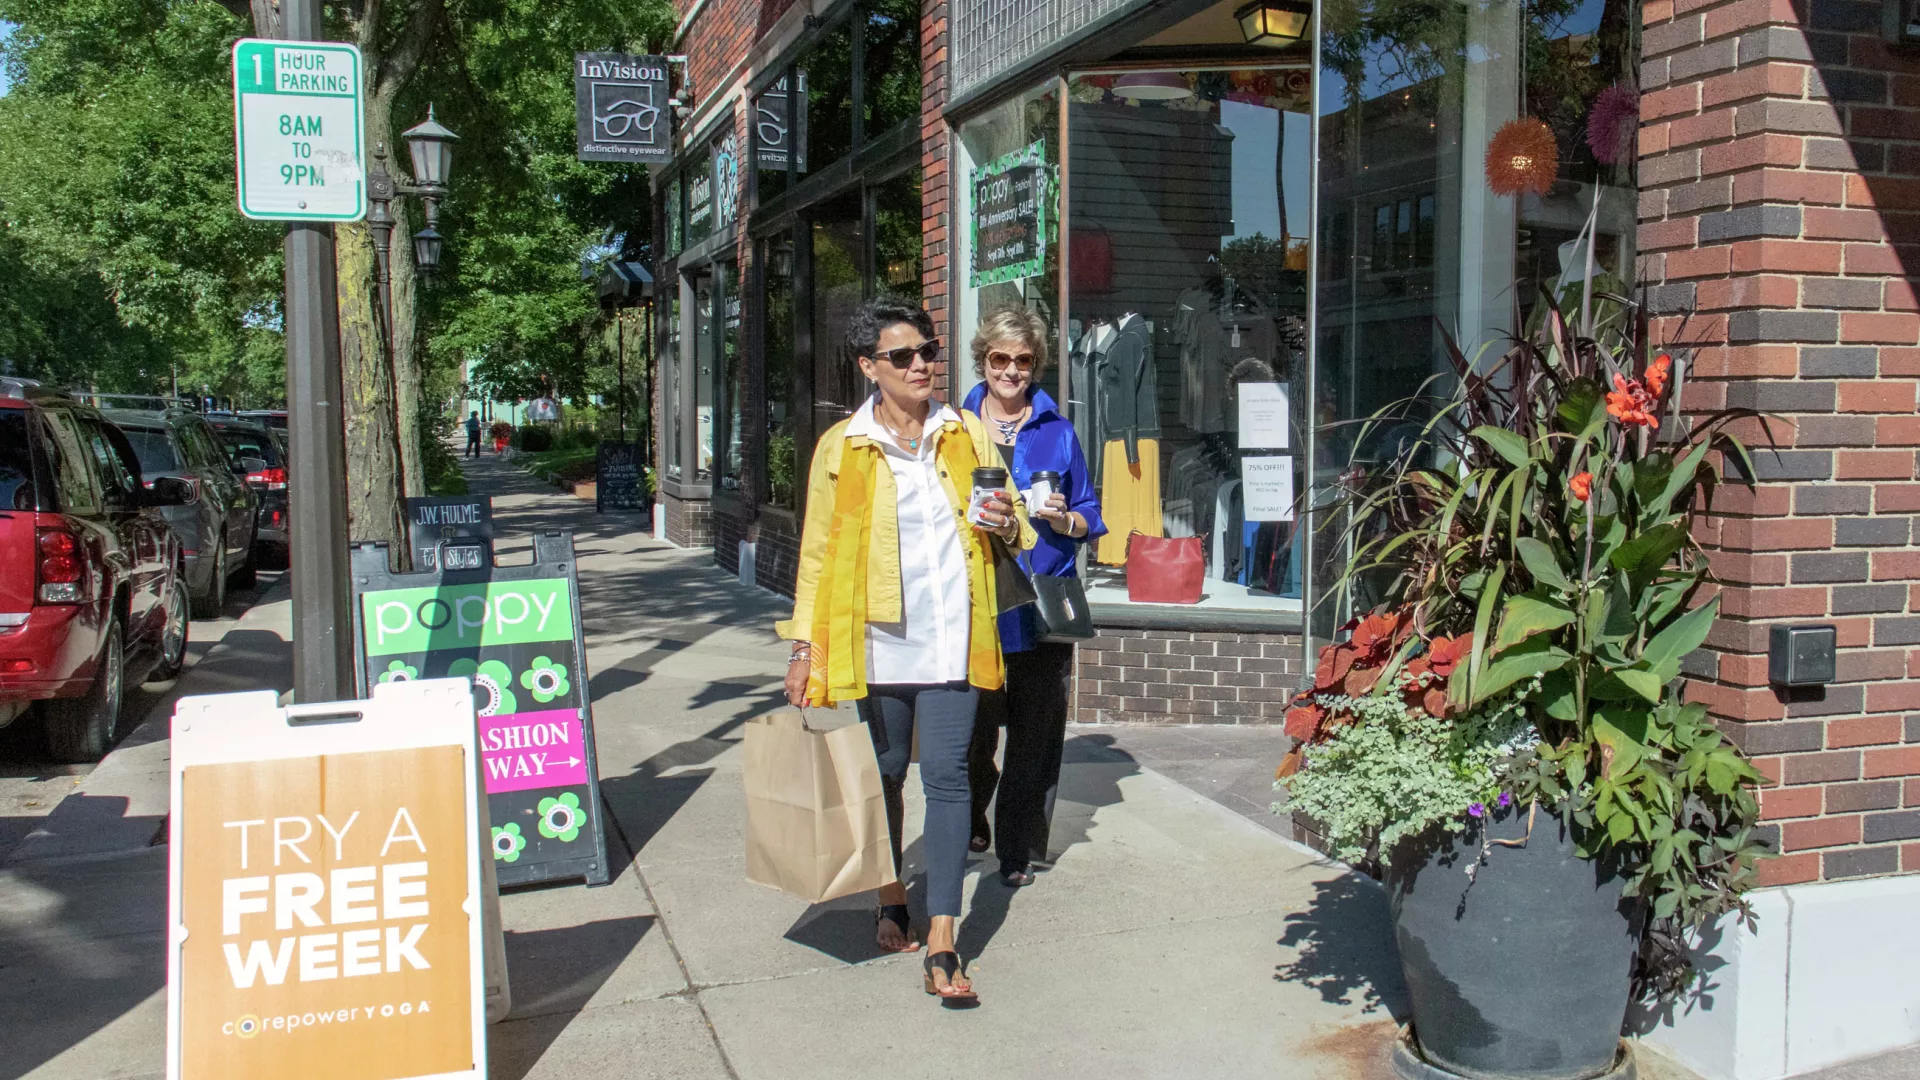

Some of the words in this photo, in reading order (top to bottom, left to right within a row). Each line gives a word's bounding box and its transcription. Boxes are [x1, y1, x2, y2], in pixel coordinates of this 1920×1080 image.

[252, 53, 262, 86] 1
[280, 52, 326, 71] HOUR
[579, 59, 664, 81] InVision
[281, 73, 348, 92] PARKING
[279, 114, 323, 137] 8AM
[292, 142, 311, 159] TO
[583, 144, 627, 154] distinctive
[629, 147, 666, 155] eyewear
[280, 164, 325, 186] 9PM
[980, 178, 1010, 210] poppy
[987, 208, 1018, 226] Anniversary
[416, 507, 438, 525] J.W.
[441, 504, 480, 524] HULME
[376, 592, 557, 645] poppy
[486, 752, 548, 780] WAY
[223, 811, 360, 869] TRY
[380, 807, 427, 857] A
[222, 861, 429, 936] FREE
[222, 924, 432, 989] WEEK
